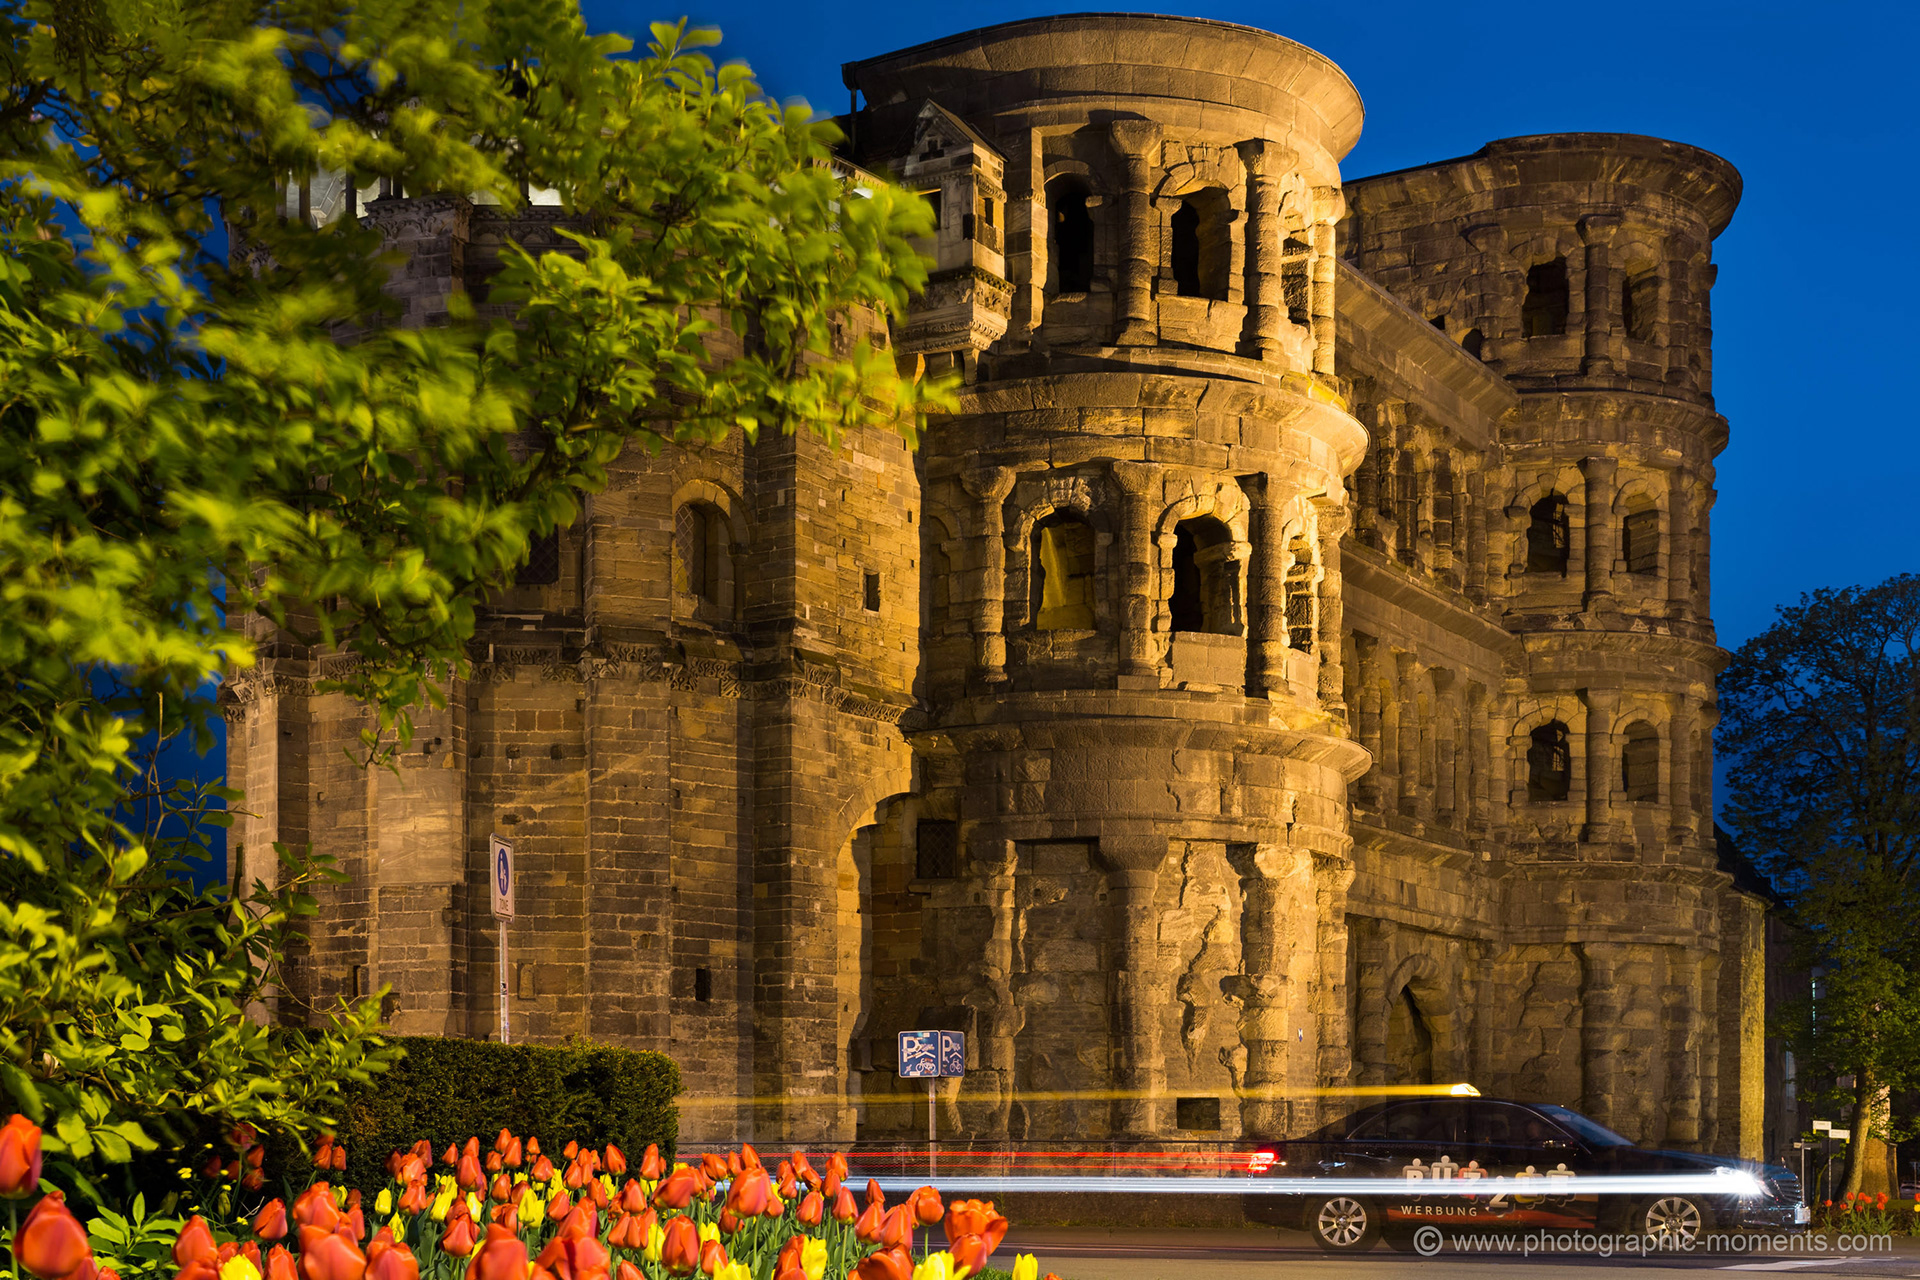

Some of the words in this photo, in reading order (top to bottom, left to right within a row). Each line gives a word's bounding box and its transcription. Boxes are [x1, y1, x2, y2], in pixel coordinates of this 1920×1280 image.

[903, 1037, 920, 1062] P
[942, 1036, 953, 1061] P
[1400, 1205, 1477, 1217] WERBUNG
